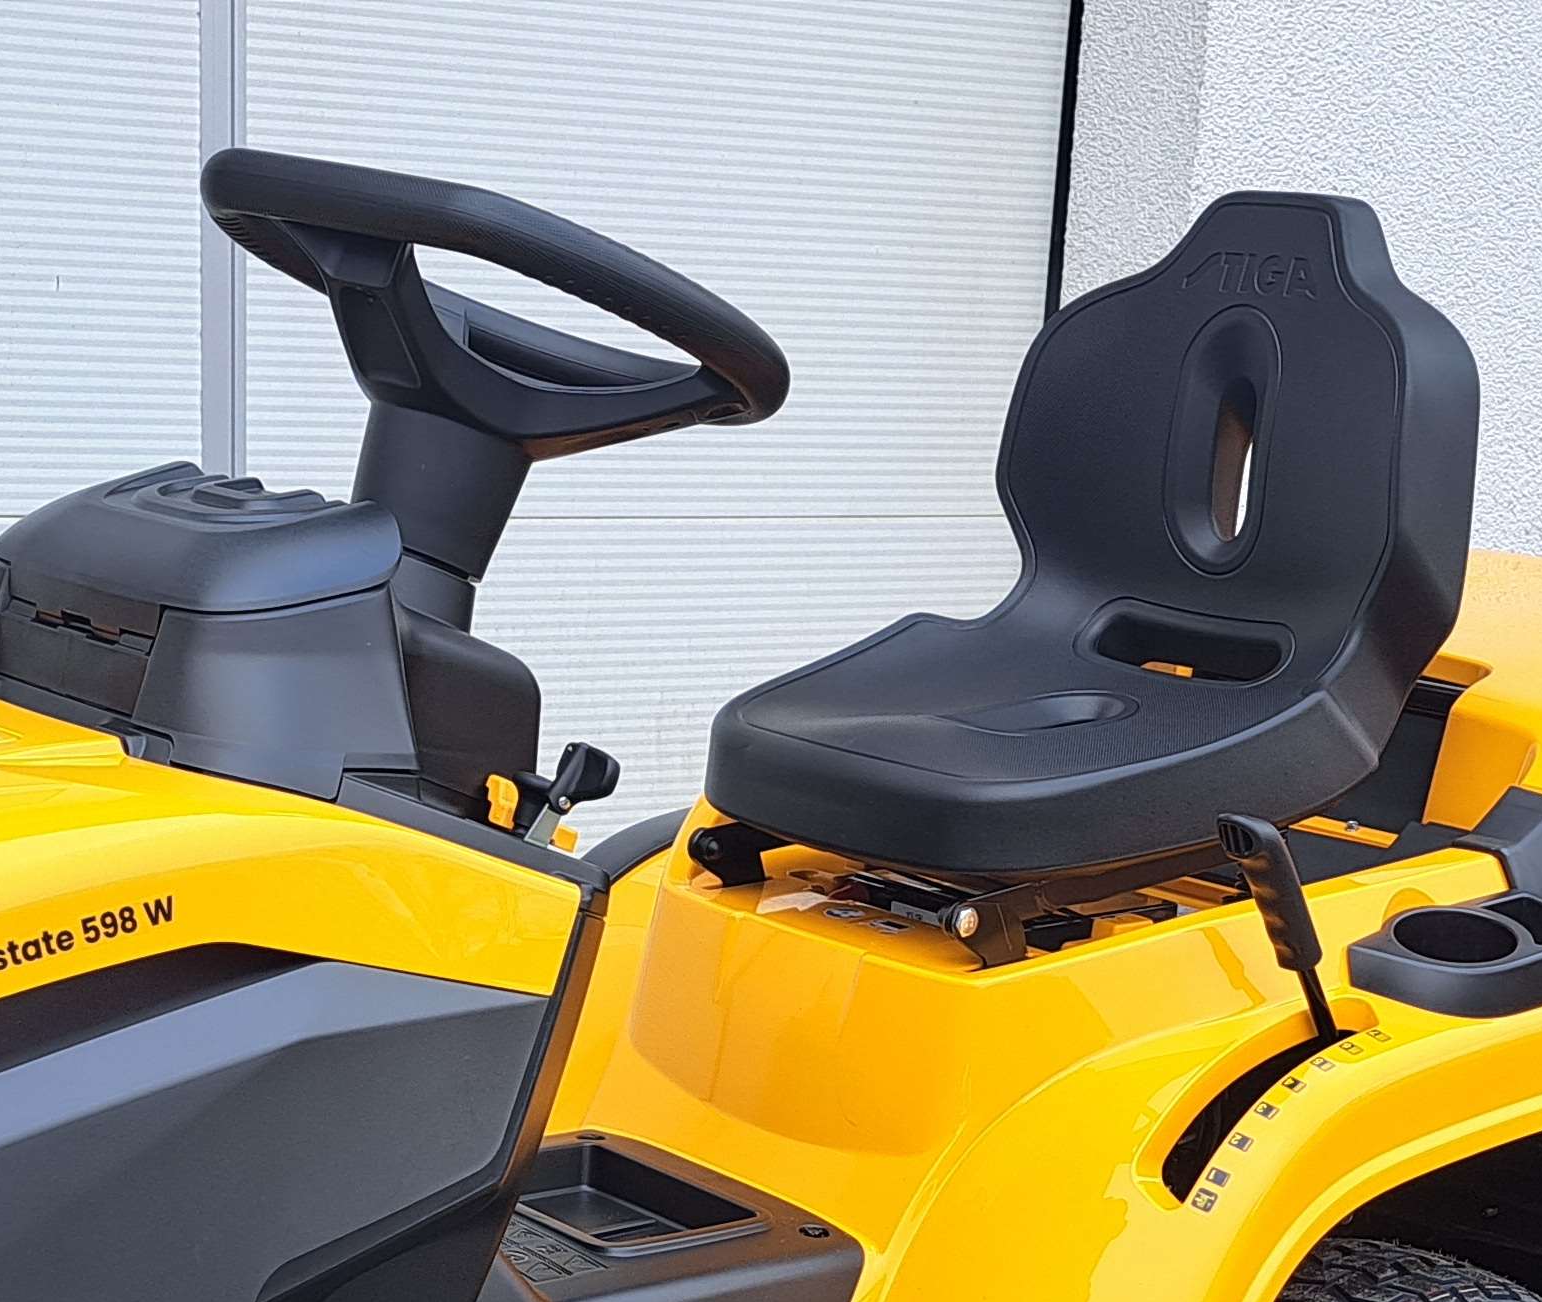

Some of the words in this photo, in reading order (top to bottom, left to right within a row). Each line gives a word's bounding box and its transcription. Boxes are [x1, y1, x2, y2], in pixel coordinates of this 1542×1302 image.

[1180, 251, 1316, 300] STIGA
[80, 906, 138, 944] 598
[143, 895, 174, 926] W
